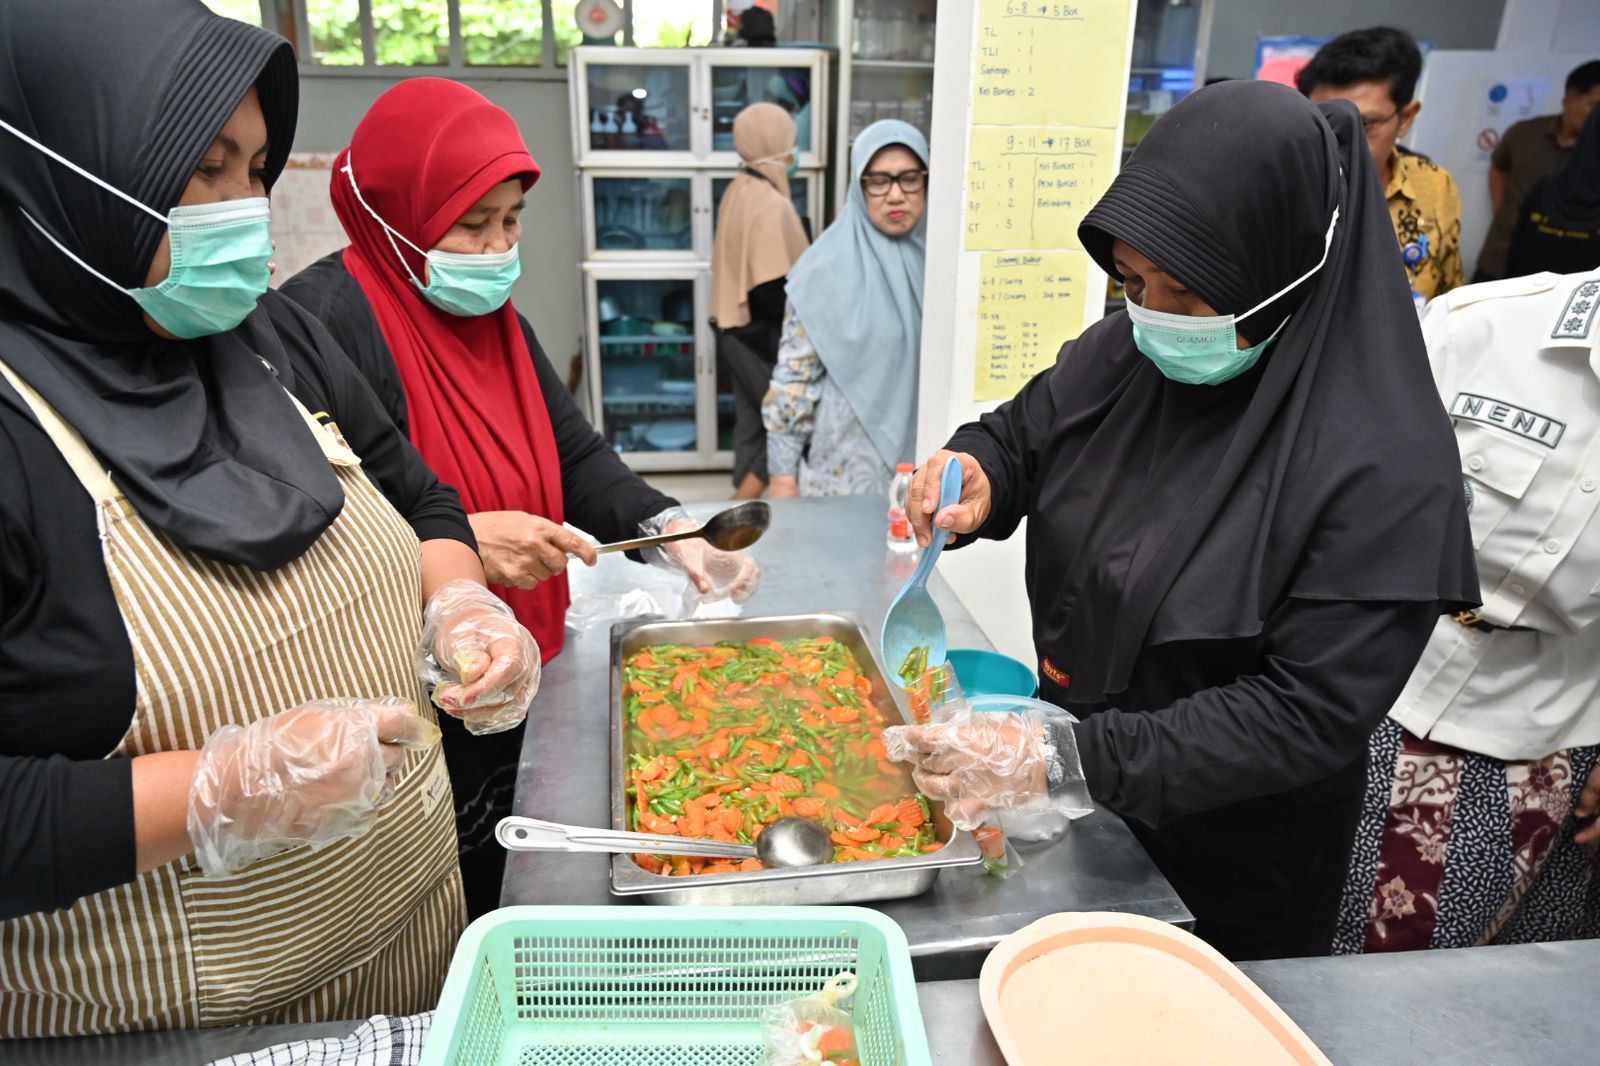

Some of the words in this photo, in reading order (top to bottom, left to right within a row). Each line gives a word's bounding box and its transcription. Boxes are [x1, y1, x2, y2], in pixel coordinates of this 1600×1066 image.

[1053, 5, 1060, 16] 5
[984, 26, 998, 37] TL
[1028, 87, 1036, 97] 2
[1059, 137, 1070, 151] 17
[1007, 198, 1016, 208] 2
[1461, 397, 1552, 438] NENI
